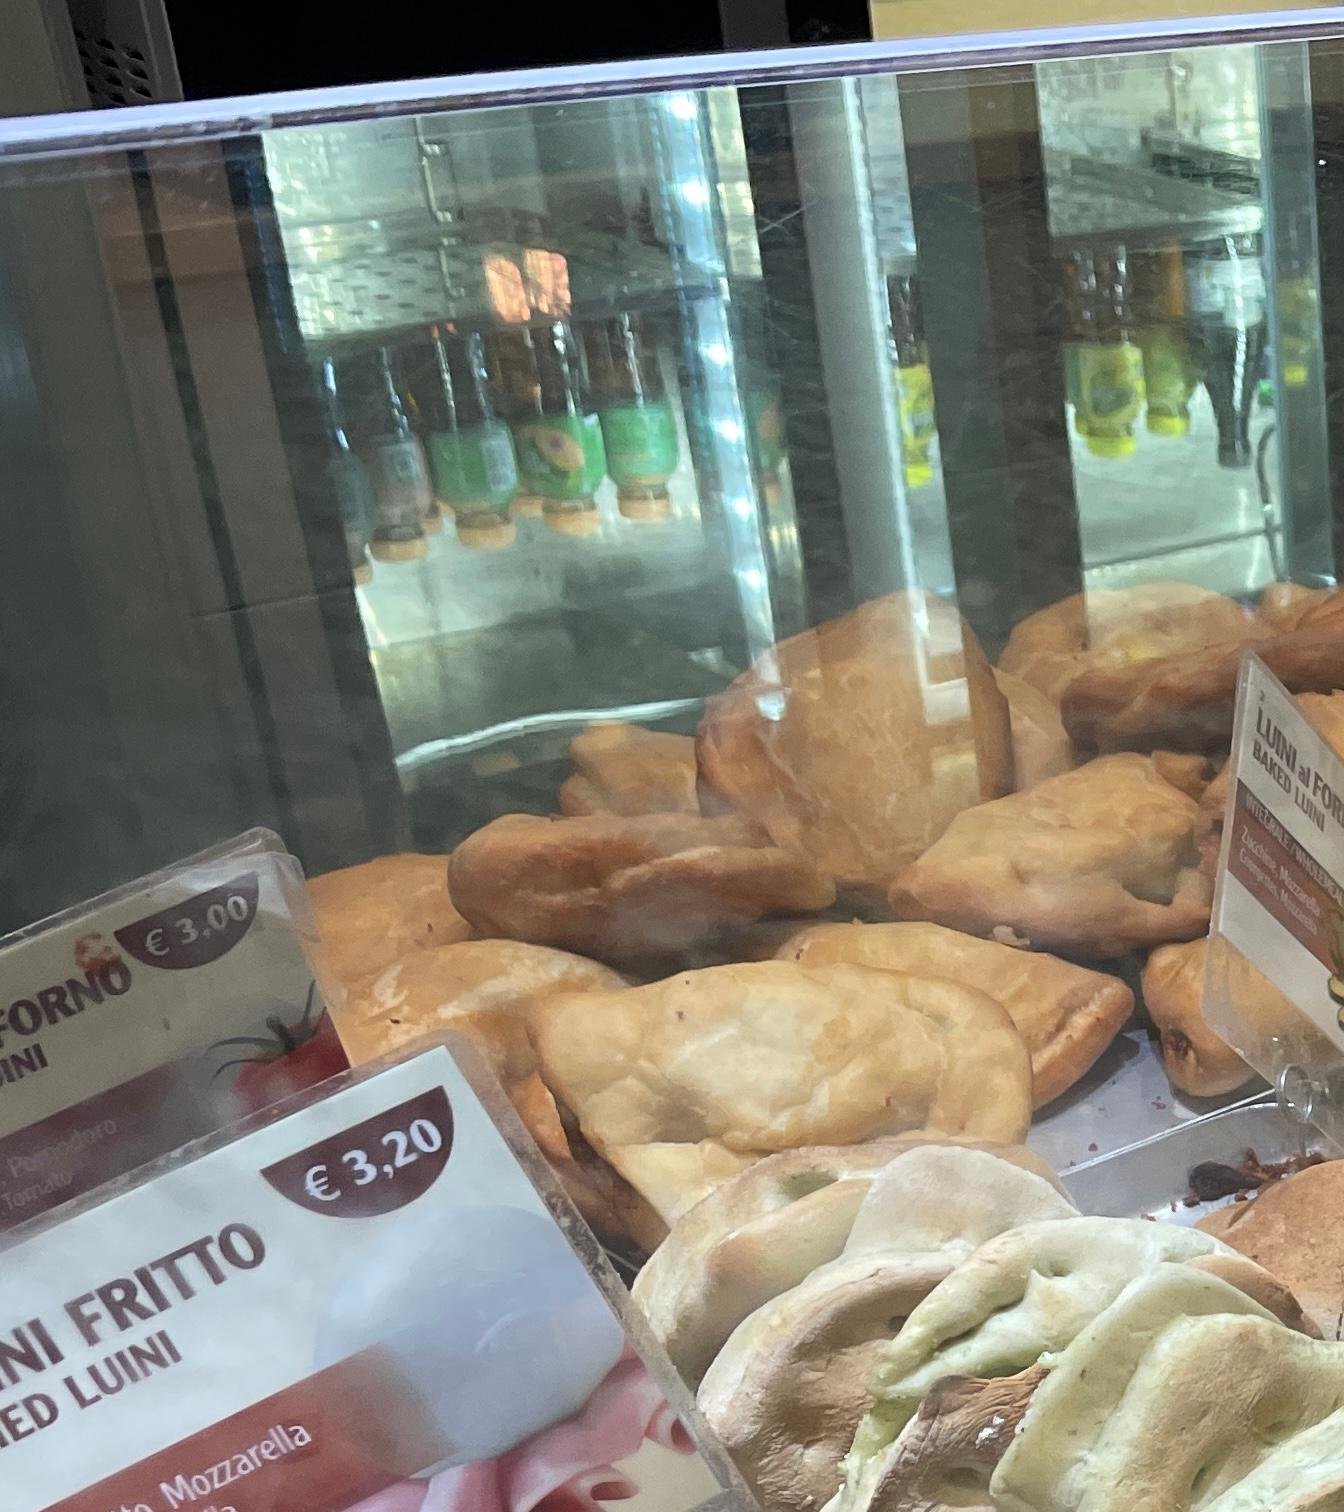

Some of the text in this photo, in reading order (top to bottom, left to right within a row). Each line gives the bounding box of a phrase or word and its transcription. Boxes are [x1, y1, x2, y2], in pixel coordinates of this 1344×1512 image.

[1252, 739, 1325, 833] BAKED LUINI
[1255, 707, 1297, 772] LUINI
[1298, 763, 1312, 789] al
[145, 894, 249, 956] € 3,00
[0, 959, 132, 1048] ORNO
[0, 1043, 48, 1087] INI
[303, 1118, 443, 1202] € 3,20
[63, 1222, 266, 1348] FRITTO
[62, 1329, 183, 1410] LUINI
[159, 1420, 314, 1509] Mozzarella
